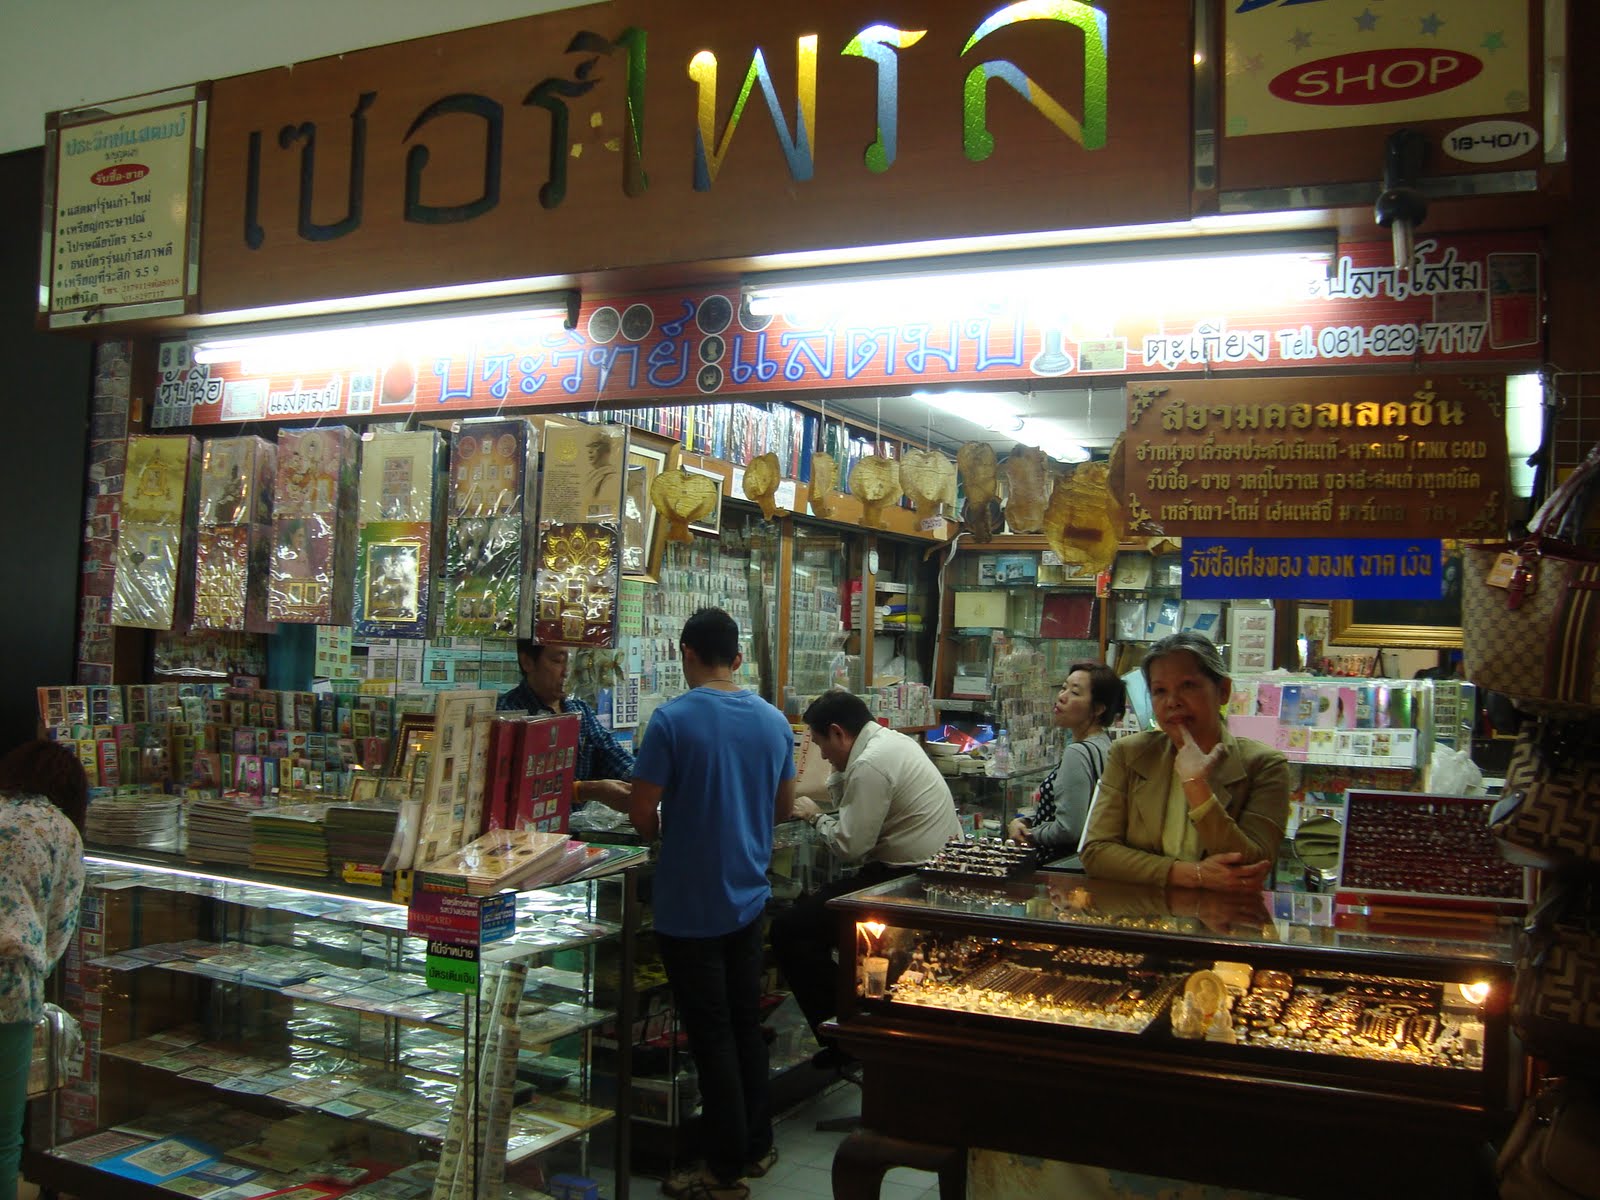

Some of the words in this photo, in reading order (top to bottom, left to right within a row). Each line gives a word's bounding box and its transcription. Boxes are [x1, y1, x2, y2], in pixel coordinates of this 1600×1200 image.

[1294, 55, 1460, 98] SHOP
[1146, 322, 1265, 362] ตะเกียง
[1280, 332, 1314, 358] Tel.
[1323, 324, 1485, 356] 081-829-7117
[1451, 440, 1488, 459] GOLD
